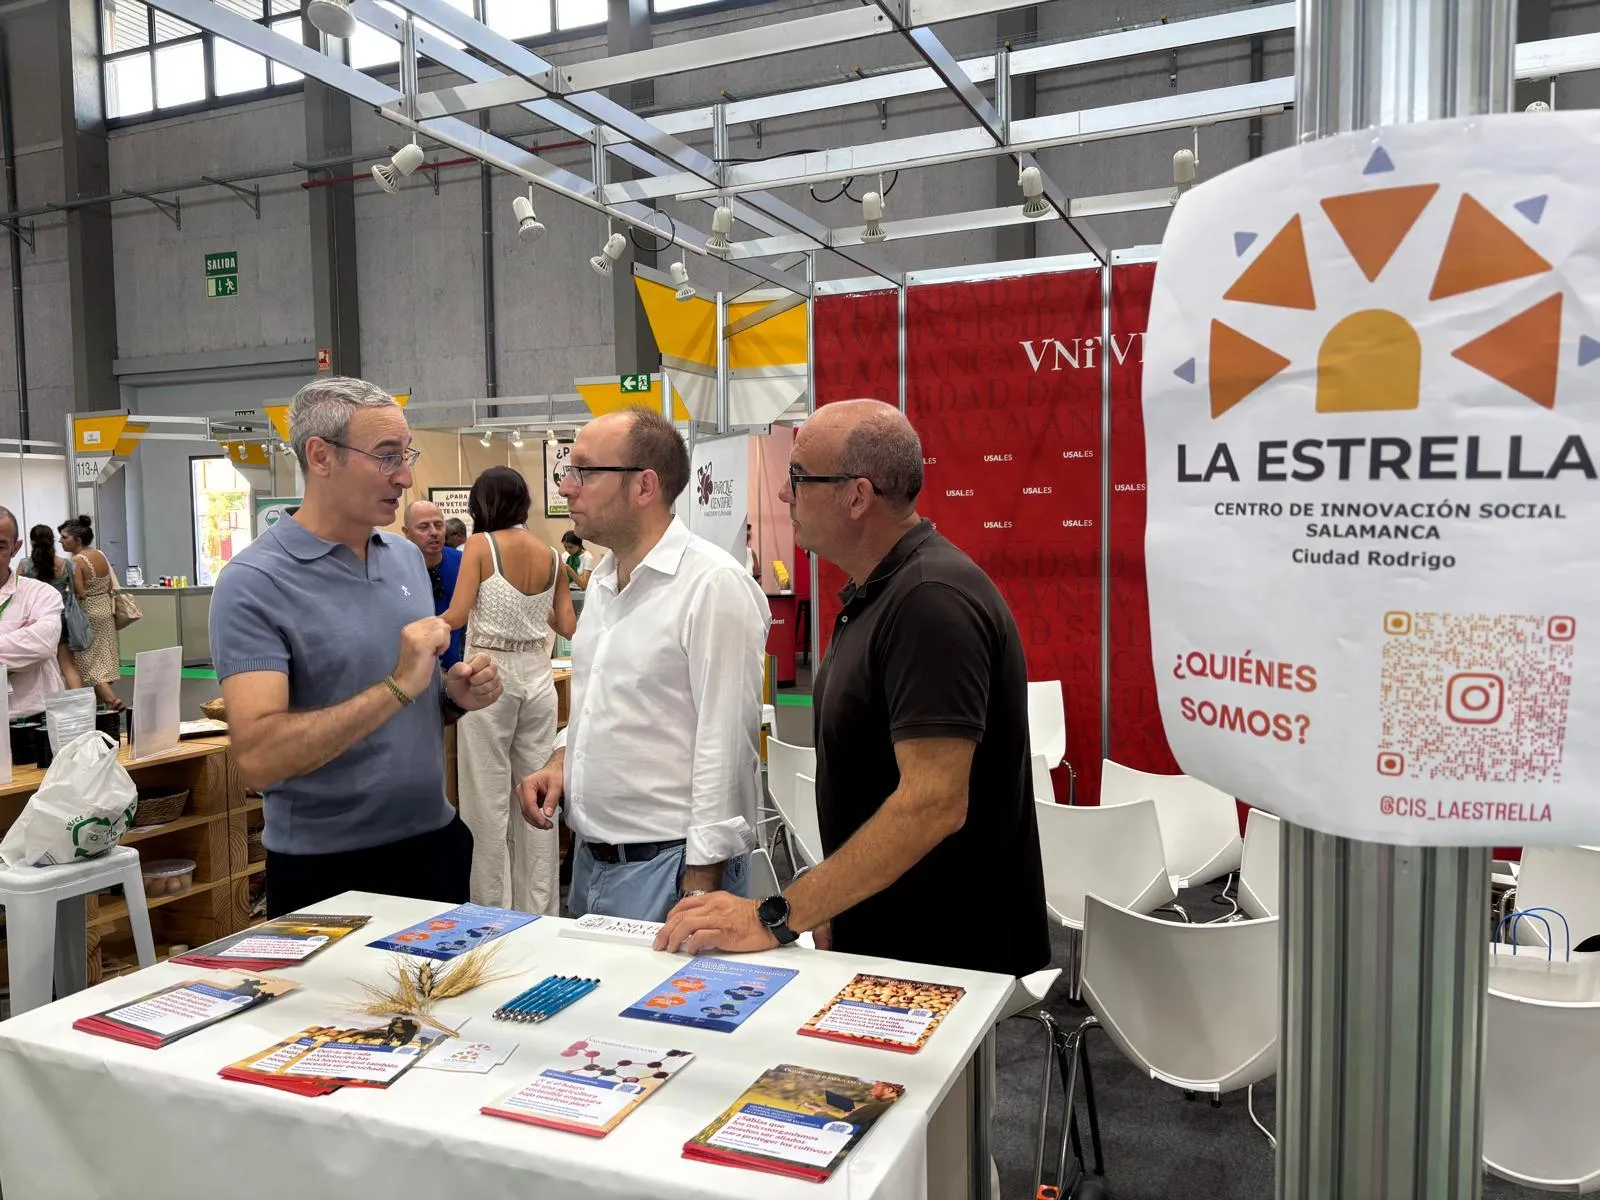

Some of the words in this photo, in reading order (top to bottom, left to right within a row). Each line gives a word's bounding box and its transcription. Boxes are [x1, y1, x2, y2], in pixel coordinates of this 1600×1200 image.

[207, 257, 236, 270] SALIDA
[76, 461, 99, 476] 113-A
[1177, 442, 1240, 483] LA
[1257, 435, 1598, 482] ESTRELLA
[1214, 502, 1283, 518] CENTRO
[1289, 503, 1314, 517] DE
[1320, 499, 1470, 519] INNOVACIÓN
[1478, 503, 1566, 519] SOCIAL
[1305, 523, 1440, 541] SALAMANCA
[1292, 548, 1359, 566] Ciudad
[1368, 550, 1456, 571] Rodrigo
[1173, 649, 1318, 693] ¿QUIÉNES
[1180, 696, 1311, 745] SOMOS?
[1379, 795, 1552, 822] @CIS_LAESTRELLA
[769, 1121, 785, 1129] que
